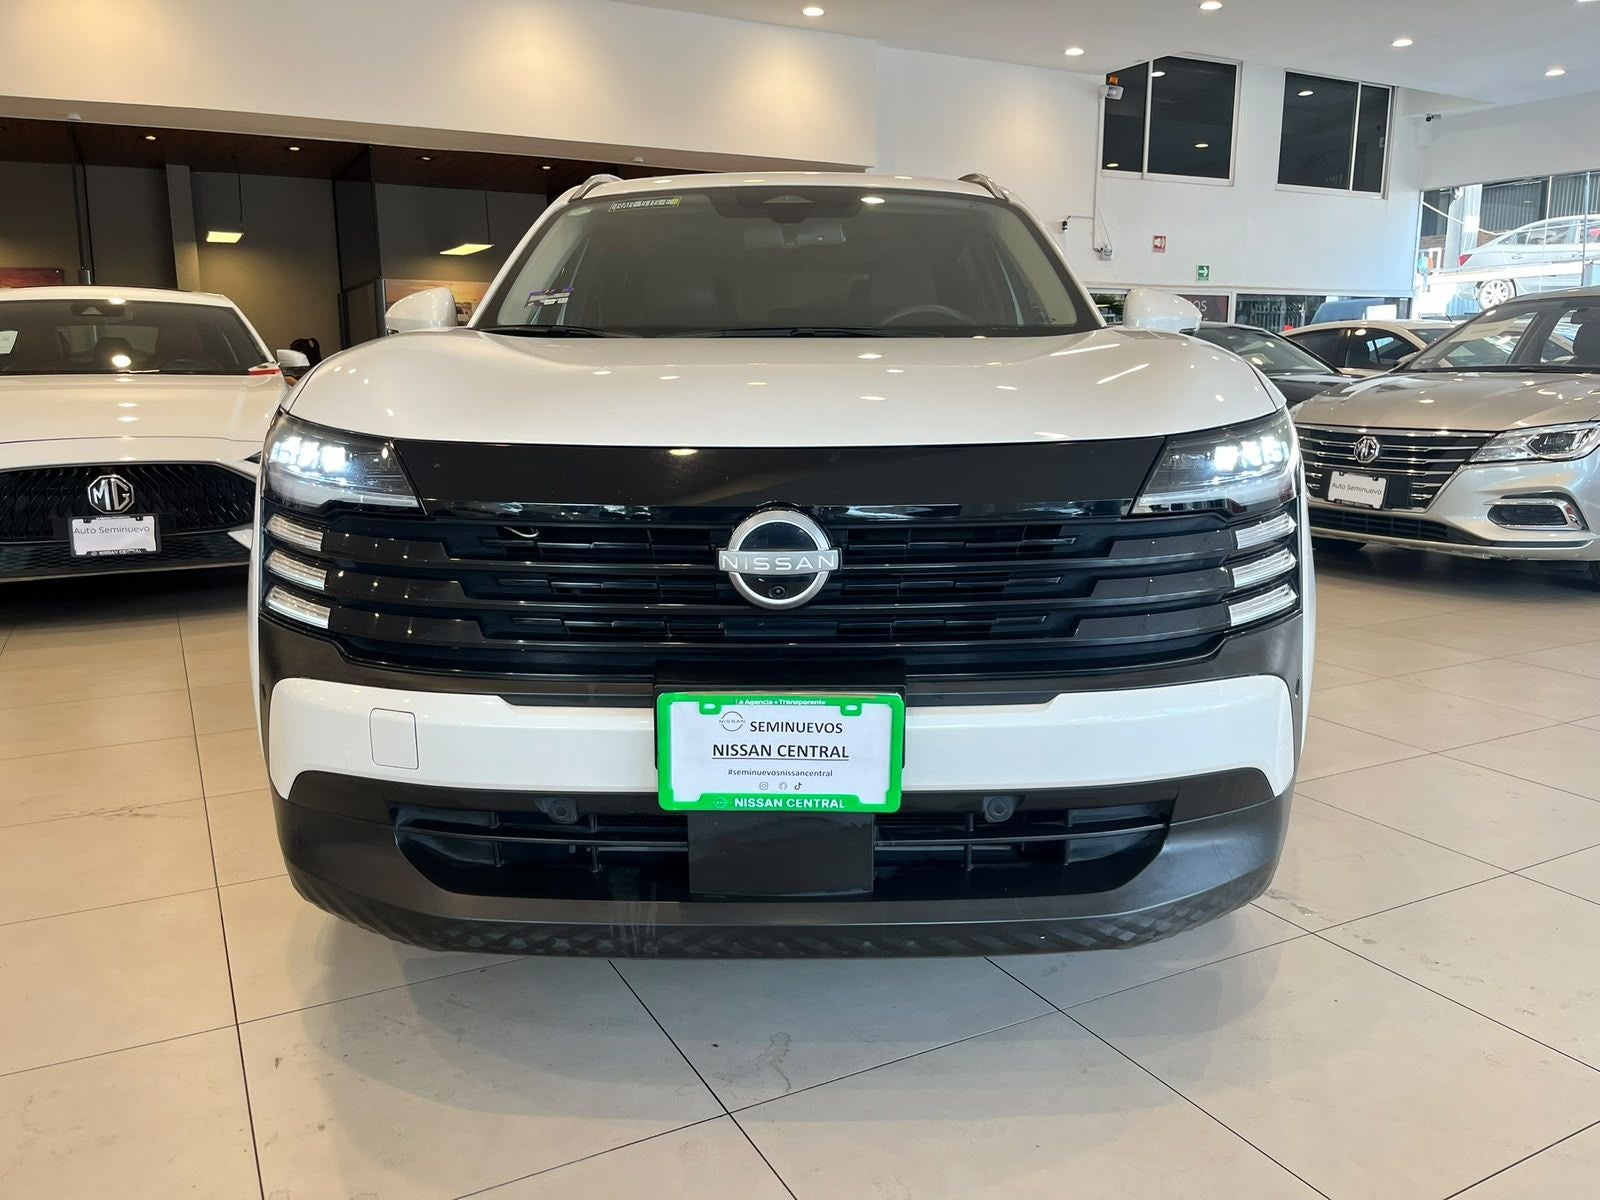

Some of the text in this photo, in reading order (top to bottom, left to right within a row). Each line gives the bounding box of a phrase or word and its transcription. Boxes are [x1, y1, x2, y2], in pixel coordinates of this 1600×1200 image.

[92, 477, 131, 511] MG
[1331, 482, 1382, 495] Auto Seminuevo
[98, 525, 151, 534] Seminuevo
[721, 554, 835, 571] NISSAN
[749, 720, 843, 734] SEMINUEVOS
[712, 744, 849, 758] NISSAN CENTRAL
[727, 768, 833, 777] #seminuevosnissancentral
[734, 797, 845, 809] NISSAN CENTRAL
